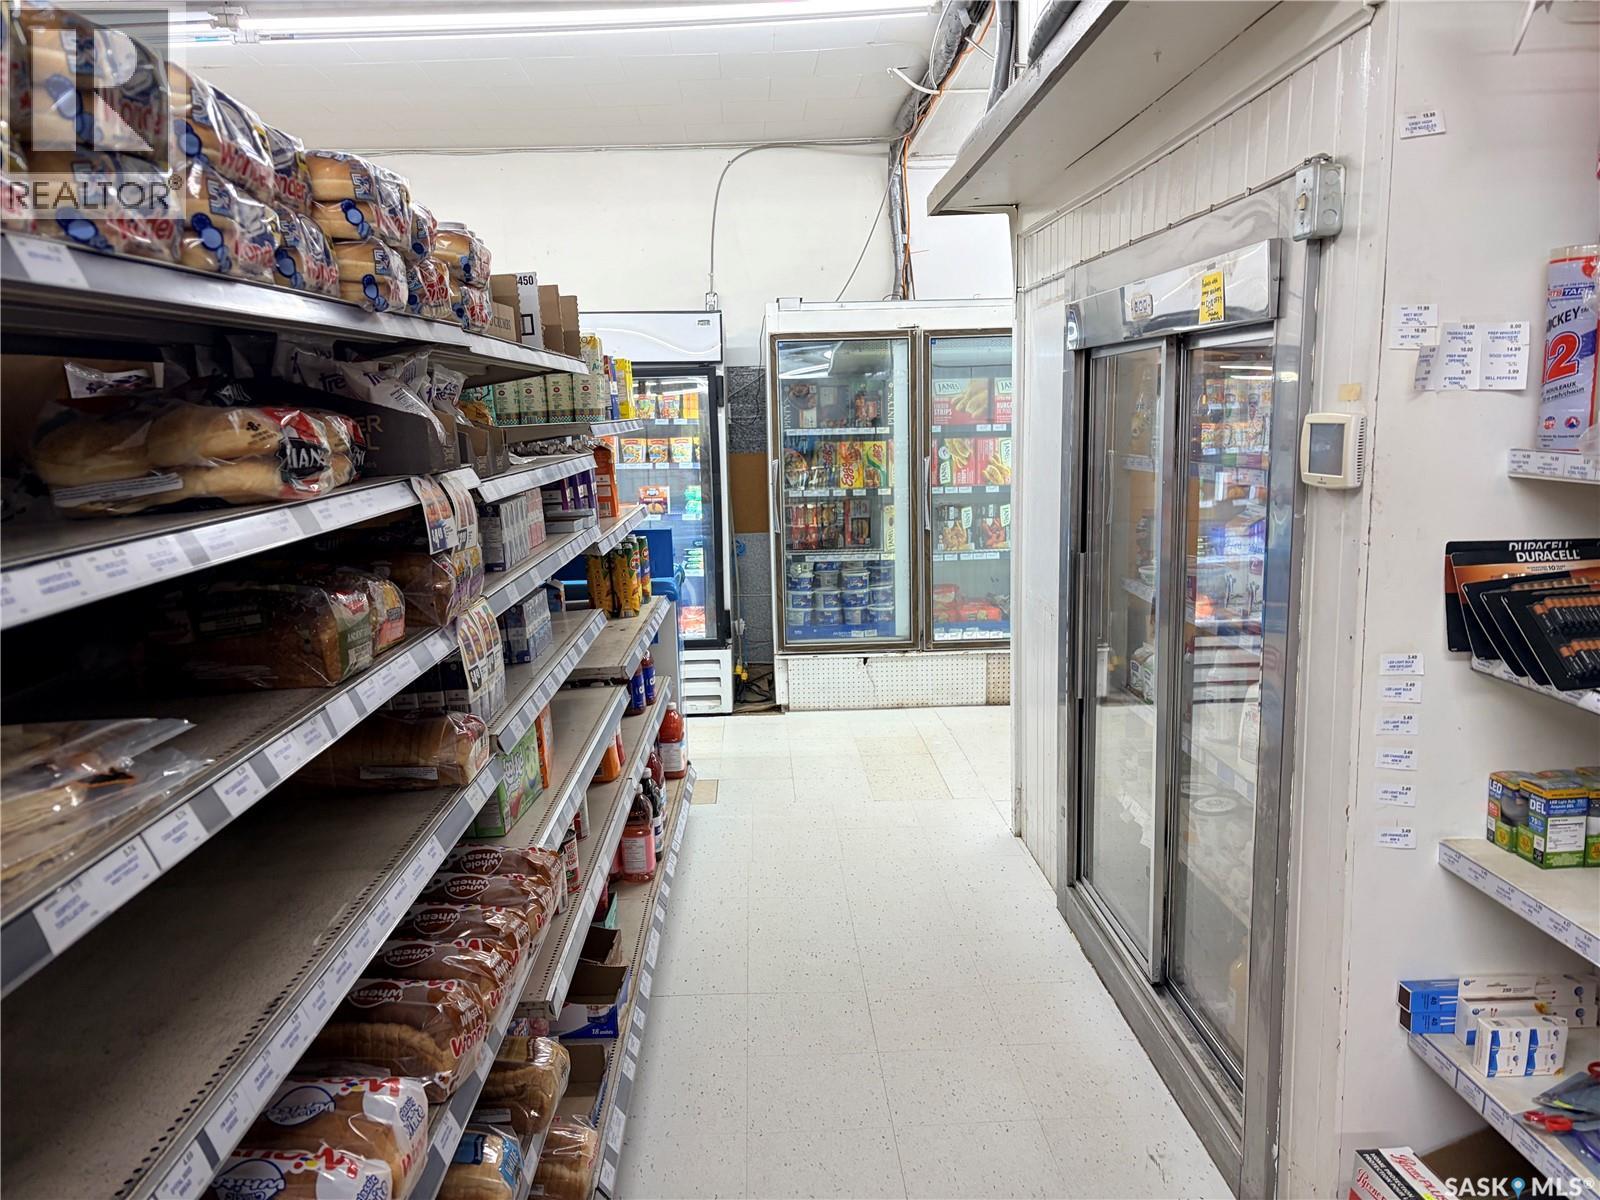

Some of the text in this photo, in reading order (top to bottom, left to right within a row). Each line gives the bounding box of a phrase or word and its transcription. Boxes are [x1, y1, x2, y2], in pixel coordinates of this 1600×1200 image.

[517, 275, 534, 286] 450
[1515, 551, 1580, 563] DURACELL
[1529, 799, 1547, 815] DEL
